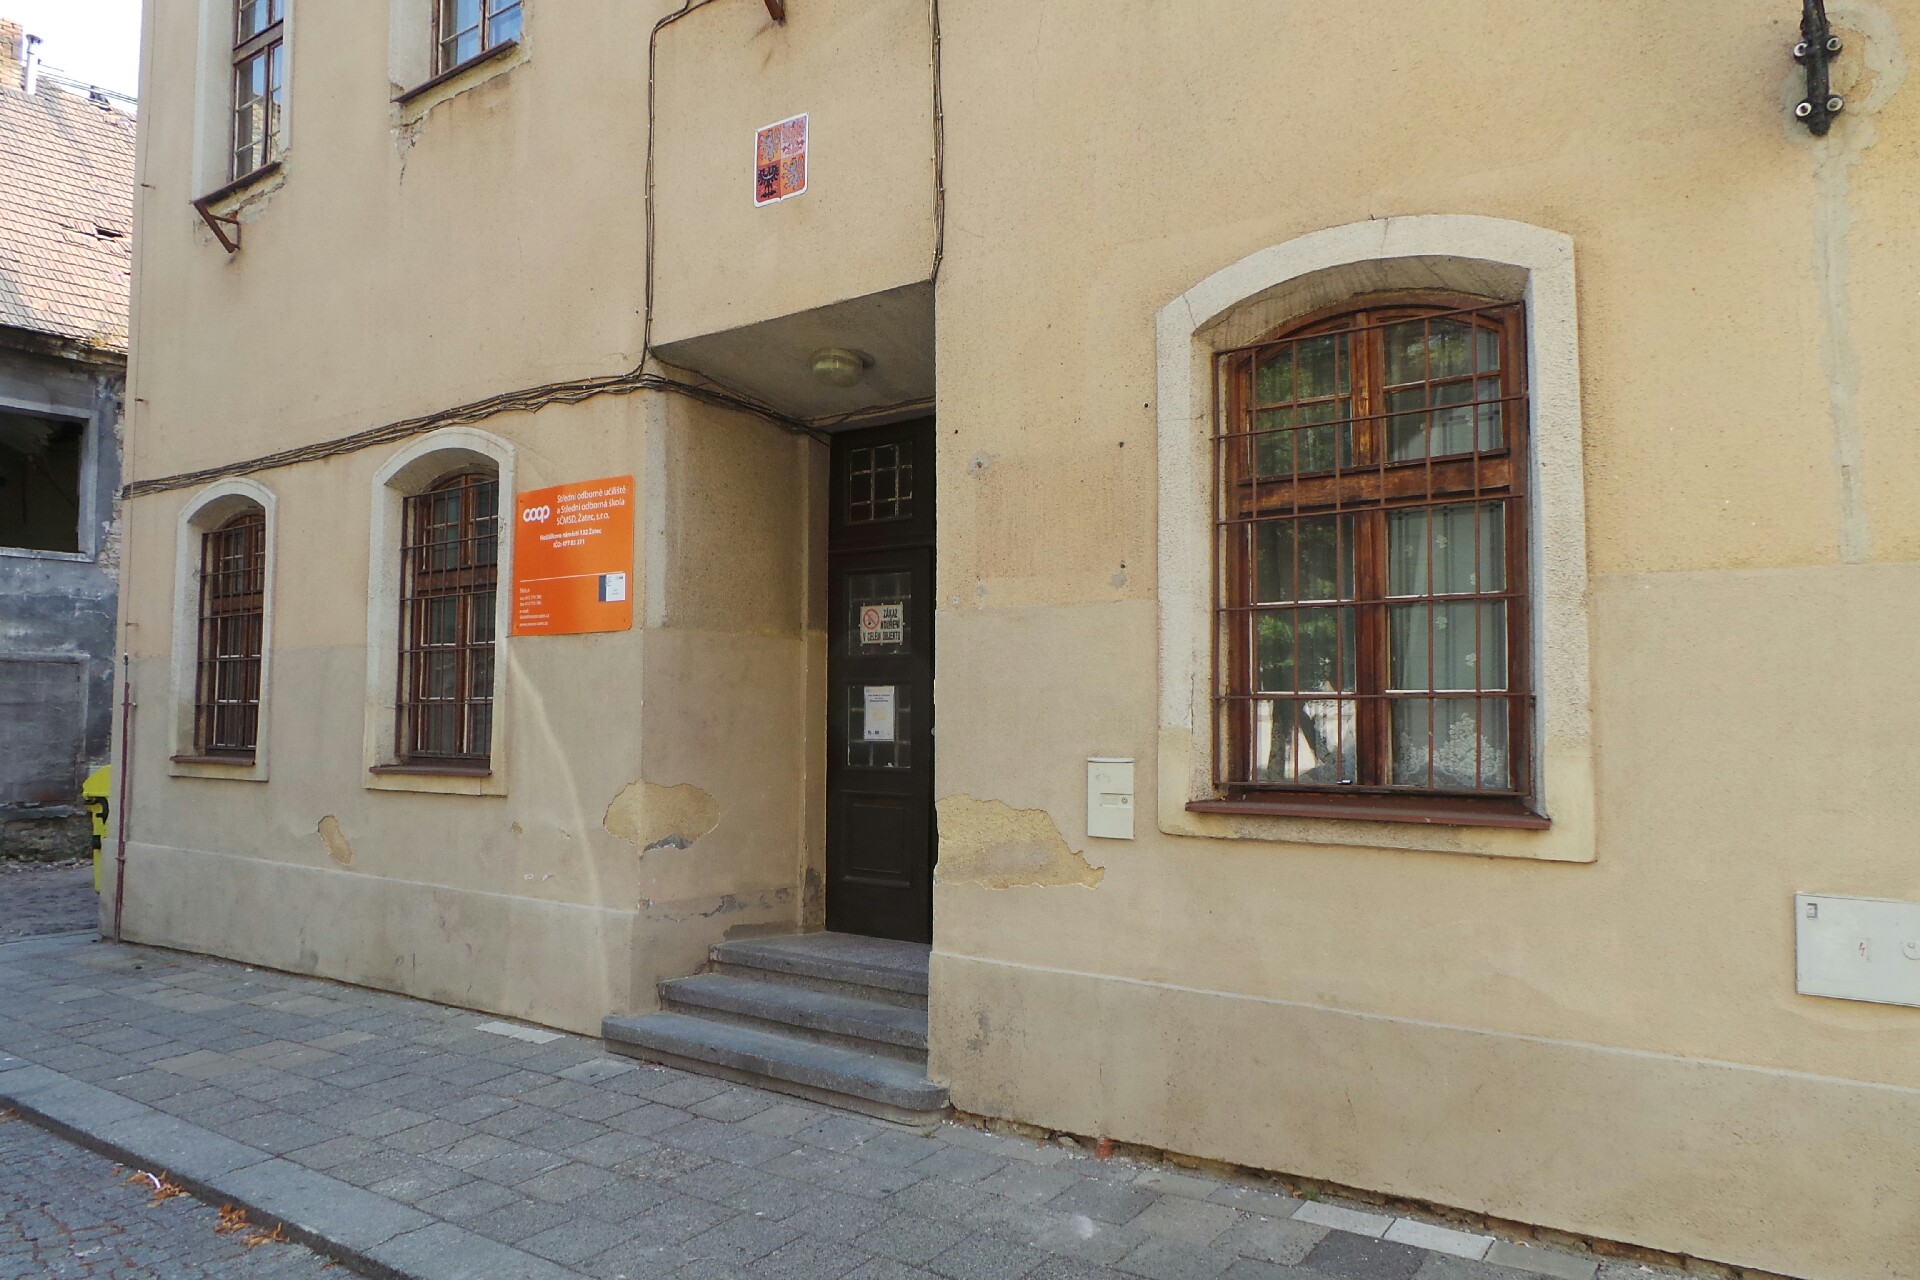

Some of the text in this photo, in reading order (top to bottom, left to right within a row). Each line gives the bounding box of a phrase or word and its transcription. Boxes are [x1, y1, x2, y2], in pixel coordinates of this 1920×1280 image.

[557, 486, 626, 503] Střední odborné učiliště
[561, 503, 580, 513] Střední
[581, 499, 608, 510] odborná
[609, 497, 625, 507] škola
[523, 505, 550, 523] coop
[883, 607, 898, 618] ZÁKAZ
[863, 632, 867, 641] V
